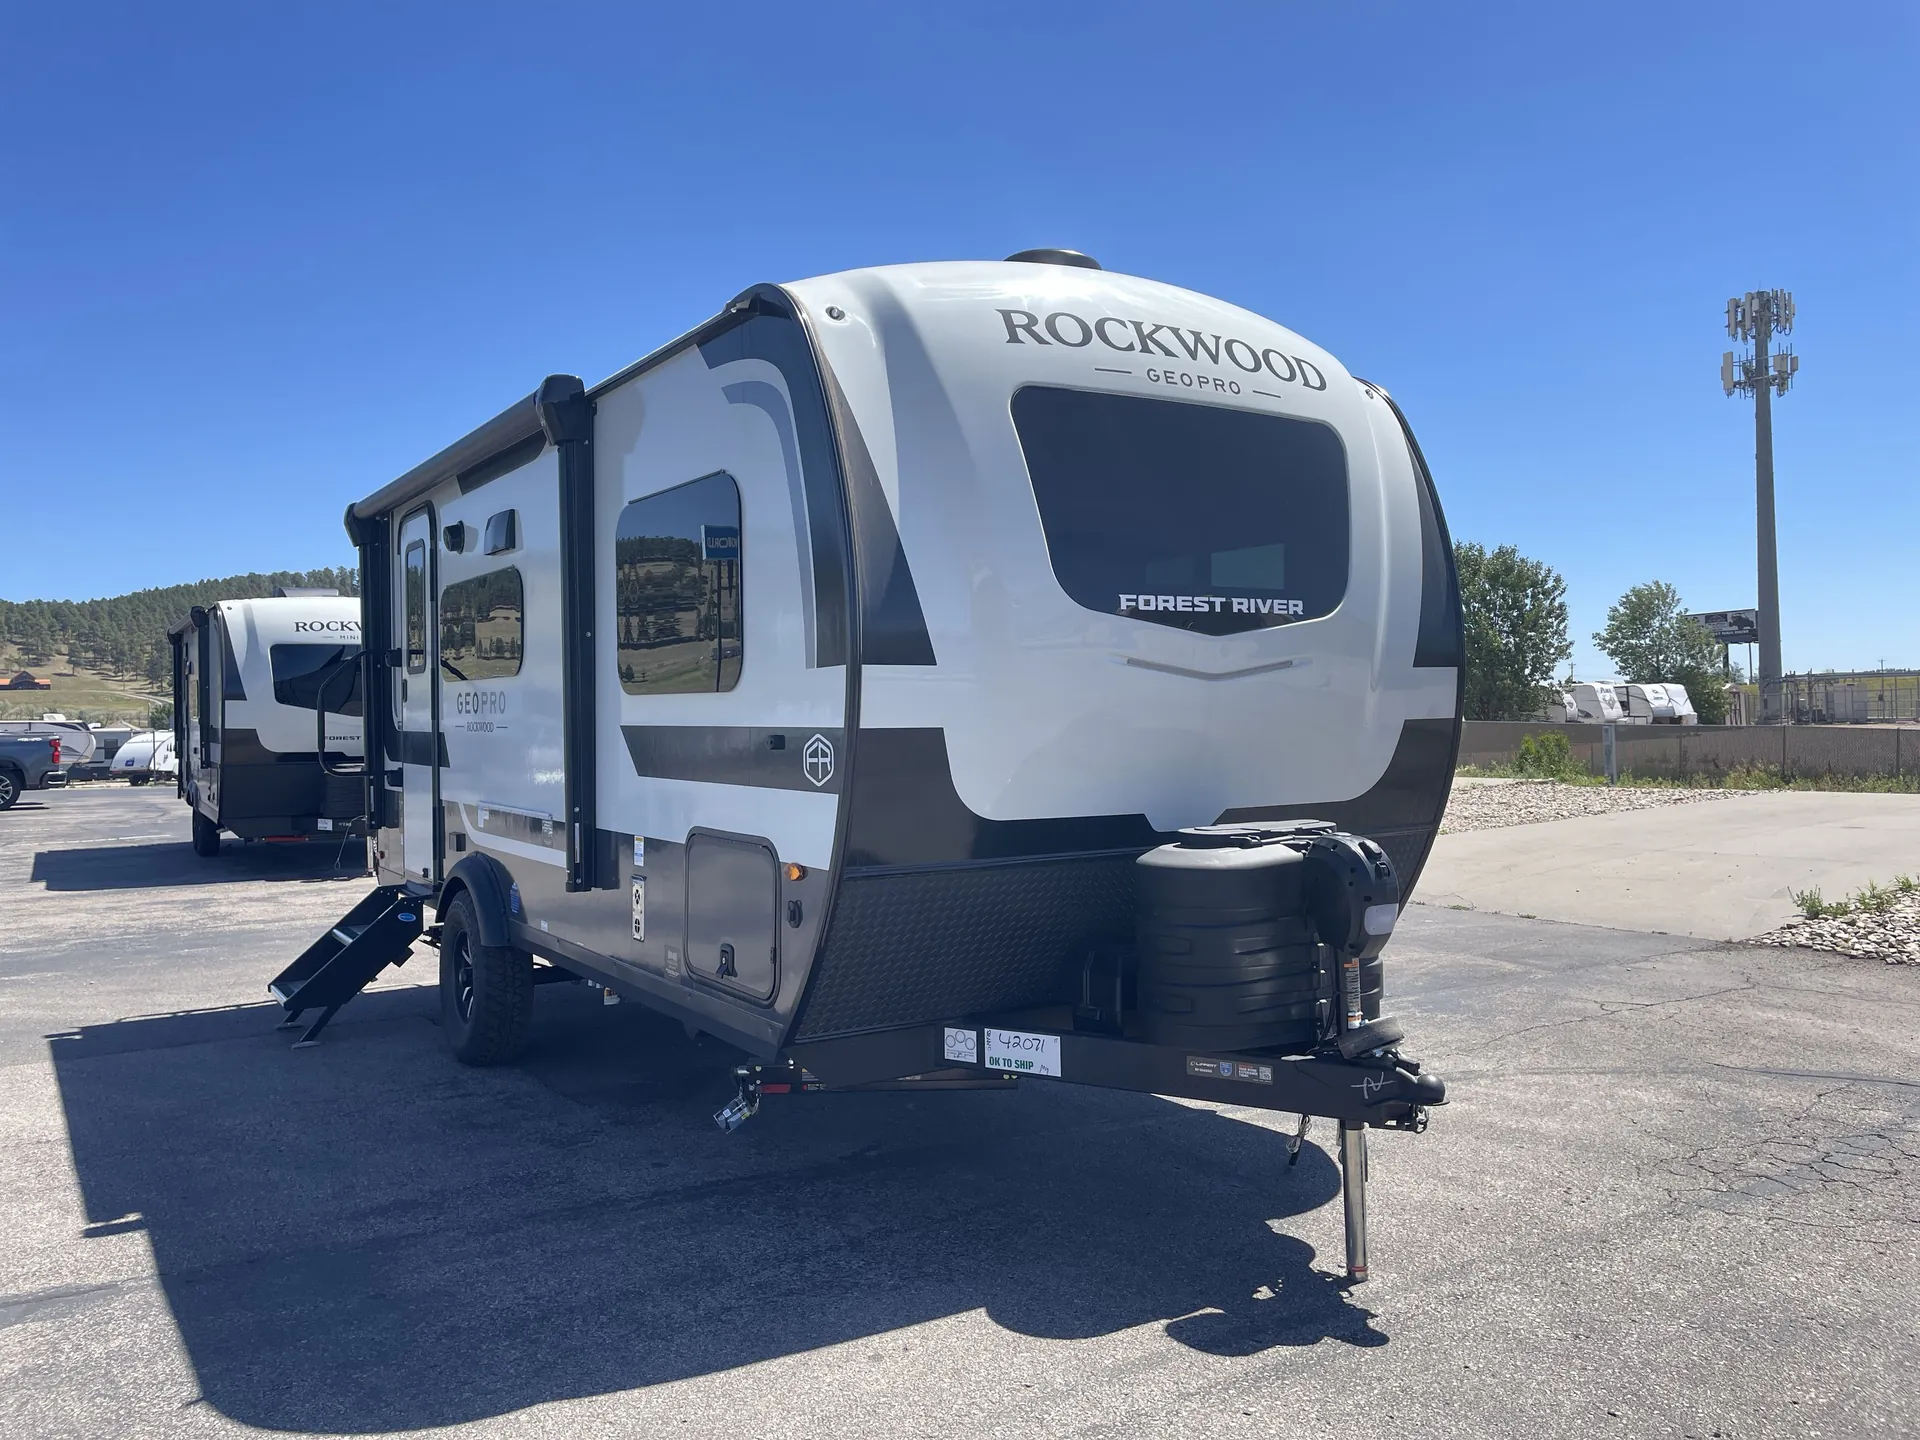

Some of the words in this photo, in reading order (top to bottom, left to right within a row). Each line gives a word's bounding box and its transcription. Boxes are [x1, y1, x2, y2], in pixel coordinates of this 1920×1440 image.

[995, 309, 1327, 391] ROCKWOOD
[1147, 368, 1240, 395] GEOPRO
[1118, 594, 1226, 613] FOREST
[1231, 598, 1303, 615] RIVER
[457, 691, 506, 714] GEOPRO
[467, 721, 494, 732] ROCKWOOD
[999, 1033, 1045, 1053] 42071
[989, 1056, 1001, 1066] OK
[1002, 1058, 1012, 1068] TO
[1015, 1059, 1034, 1070] SHIP
